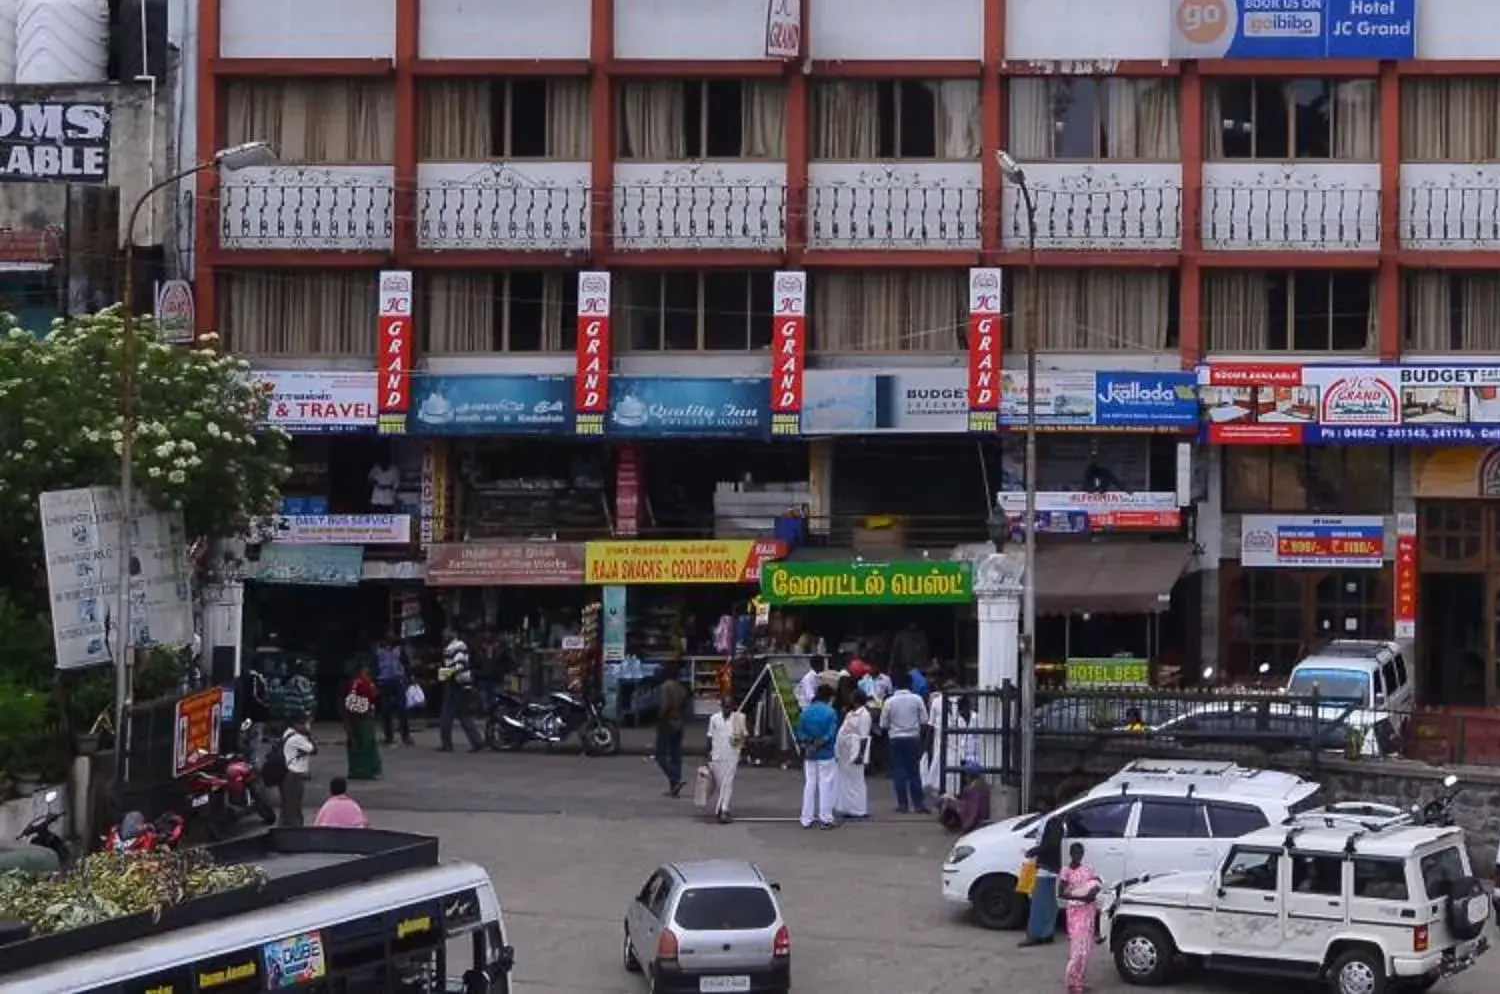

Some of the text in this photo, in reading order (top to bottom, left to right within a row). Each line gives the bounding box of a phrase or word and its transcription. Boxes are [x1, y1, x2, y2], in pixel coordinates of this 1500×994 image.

[1350, 0, 1395, 15] Hotel
[1185, 3, 1220, 31] go
[1251, 13, 1313, 32] goibibo
[1333, 20, 1411, 36] JC Grand
[0, 145, 105, 175] ABLE
[386, 321, 403, 408] GRAND
[584, 321, 601, 407] GRAND
[780, 320, 797, 407] GRAND
[977, 318, 993, 404] GRAND
[1400, 369, 1479, 383] BUDGET
[906, 390, 969, 399] BUDGE
[1338, 390, 1382, 402] GRAND
[275, 402, 289, 418] &
[722, 402, 758, 416] Inn
[592, 559, 619, 580] RAJA
[621, 559, 662, 580] SNACKS
[1069, 665, 1111, 681] HOTEL
